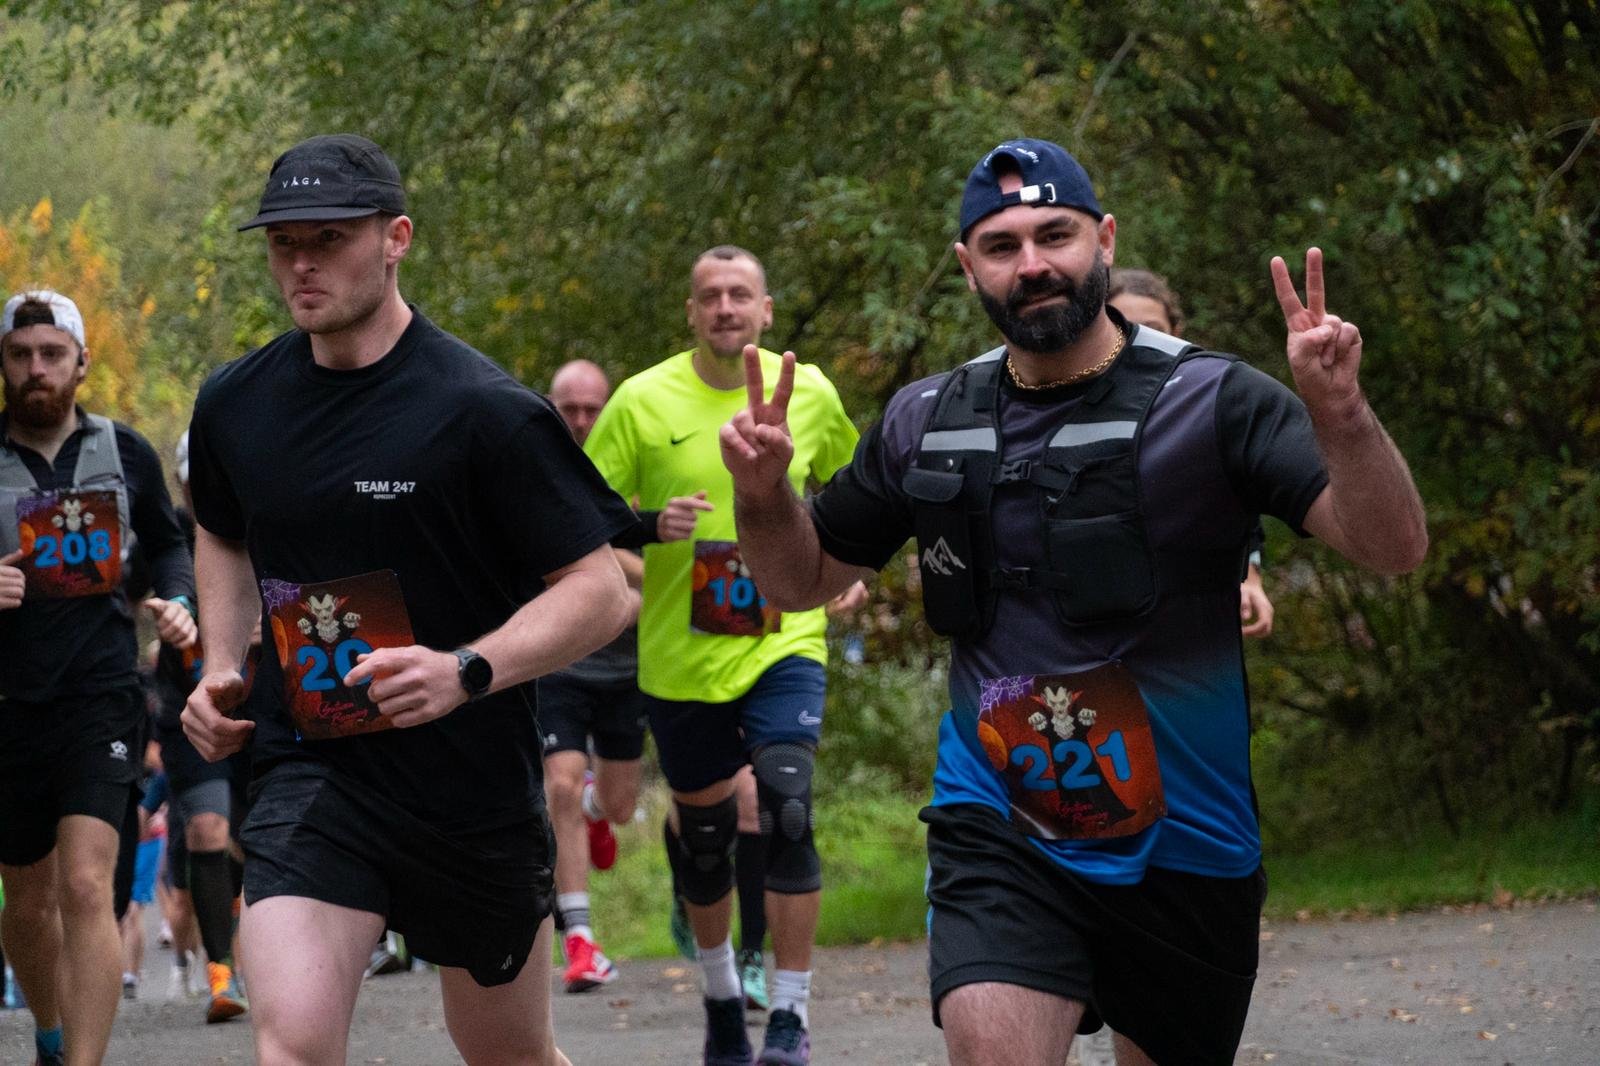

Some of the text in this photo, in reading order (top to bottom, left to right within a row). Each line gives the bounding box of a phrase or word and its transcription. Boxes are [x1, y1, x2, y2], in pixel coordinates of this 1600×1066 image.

[354, 481, 416, 493] TEAM 247
[34, 529, 112, 569] 208
[708, 576, 768, 608] 10
[1010, 730, 1132, 791] 221
